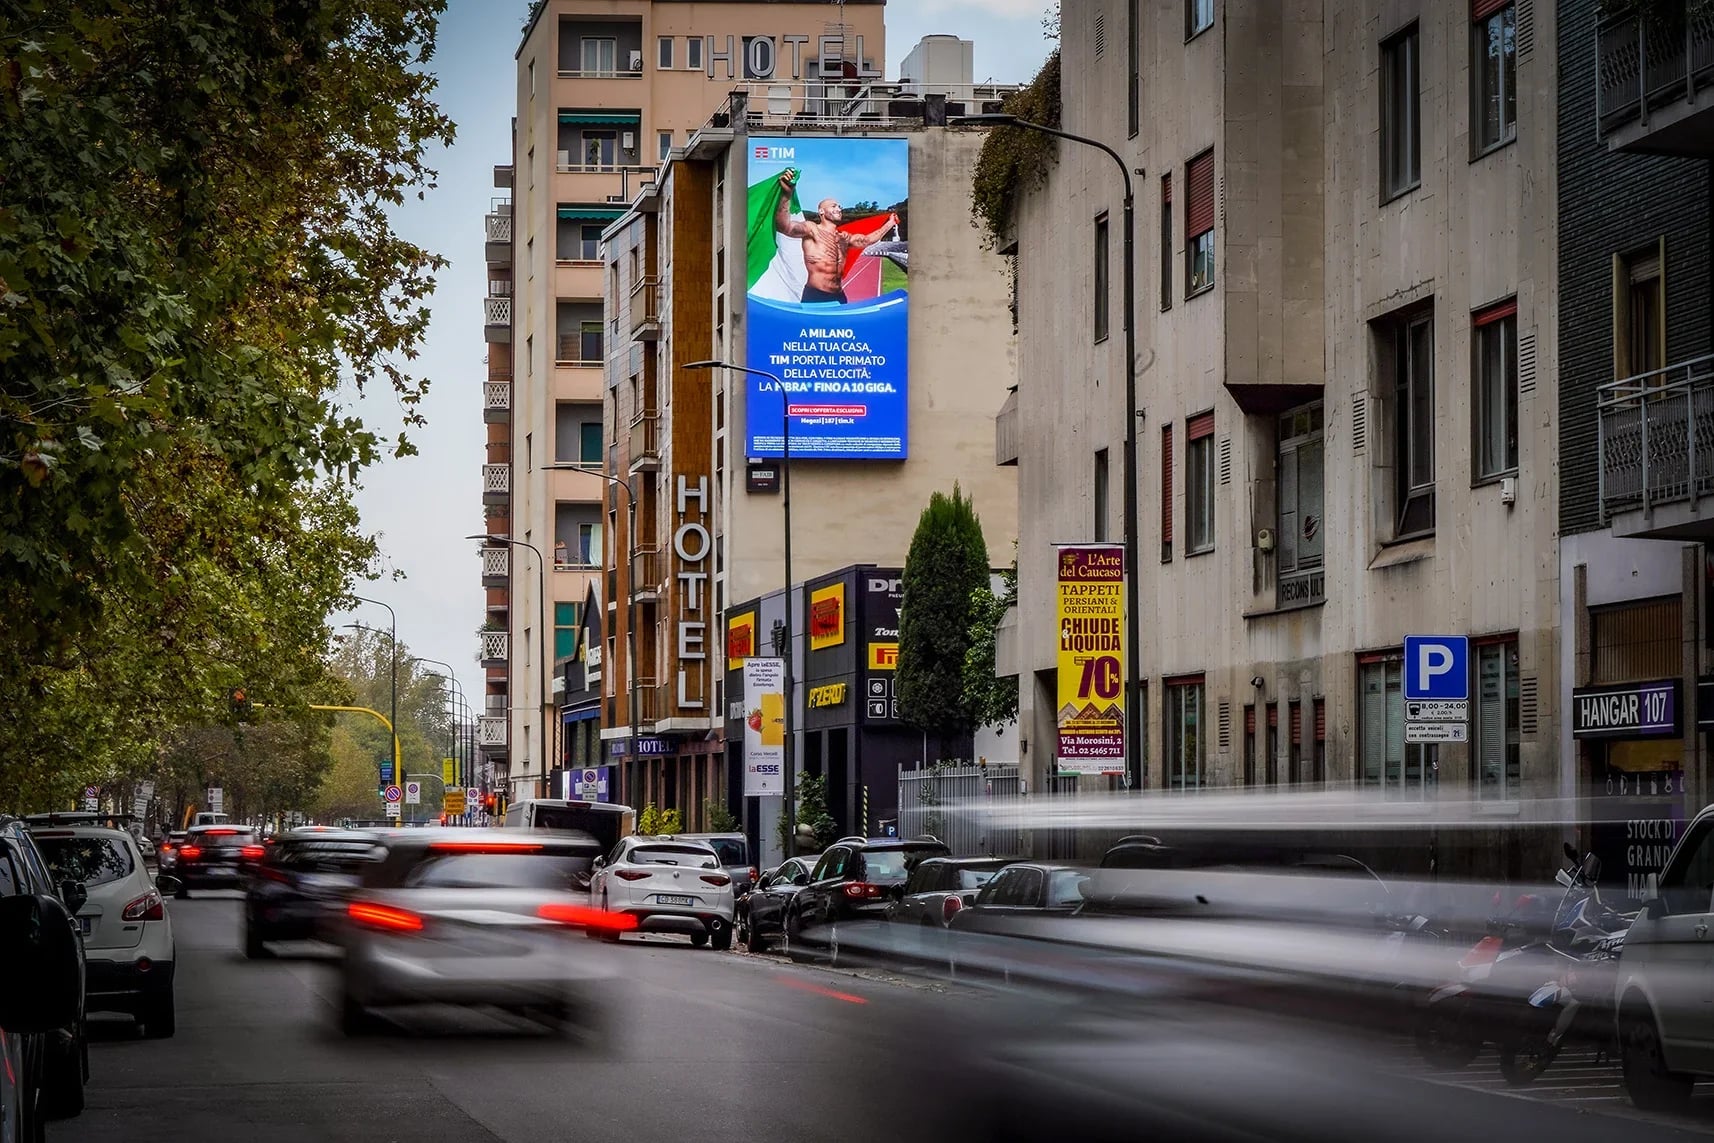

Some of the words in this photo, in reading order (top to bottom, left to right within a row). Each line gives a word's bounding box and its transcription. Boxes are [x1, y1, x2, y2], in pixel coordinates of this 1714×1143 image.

[707, 35, 882, 78] HOTEL
[770, 147, 795, 159] TIM
[799, 328, 808, 338] A
[808, 328, 856, 340] MILANO,
[783, 342, 817, 352] NELLA
[818, 342, 841, 352] TUA
[841, 342, 873, 353] CASA,
[769, 355, 790, 365] TIM
[792, 355, 828, 365] PORTA
[828, 355, 838, 366] IL
[839, 355, 886, 366] PRIMATO
[783, 368, 818, 379] DELLA
[818, 367, 871, 379] VELOCITÀ:
[759, 382, 773, 392] LA
[814, 382, 841, 393] FINO
[841, 382, 851, 393] A
[851, 382, 864, 393] 10
[865, 382, 897, 393] GIGA.
[1087, 553, 1121, 566] L'Arte
[1060, 565, 1076, 577] del
[1078, 565, 1121, 577] Caucaso
[674, 474, 711, 708] HOTEL
[869, 578, 903, 592] Dr
[1061, 585, 1120, 595] TAPPETI
[1063, 597, 1108, 605] PERSIANI
[1064, 606, 1117, 614] ORIENTALI
[1061, 618, 1120, 634] CHIUDE
[1062, 629, 1070, 639] &
[1061, 635, 1121, 653] LIQUIDA
[1418, 644, 1454, 691] P
[1581, 695, 1640, 727] HANGAR
[1644, 692, 1668, 723] 107
[1060, 736, 1075, 745] Via
[1076, 735, 1116, 746] Morosini,
[1116, 737, 1123, 745] 2
[1061, 745, 1078, 754] Tel.
[1089, 746, 1108, 756] 5465
[1108, 747, 1121, 755] 711
[748, 764, 780, 773] laESSE
[888, 826, 896, 836] P
[1627, 819, 1661, 839] STOCK
[1664, 819, 1676, 839] DI
[1627, 844, 1676, 867] GRAND
[1627, 872, 1649, 899] MA
